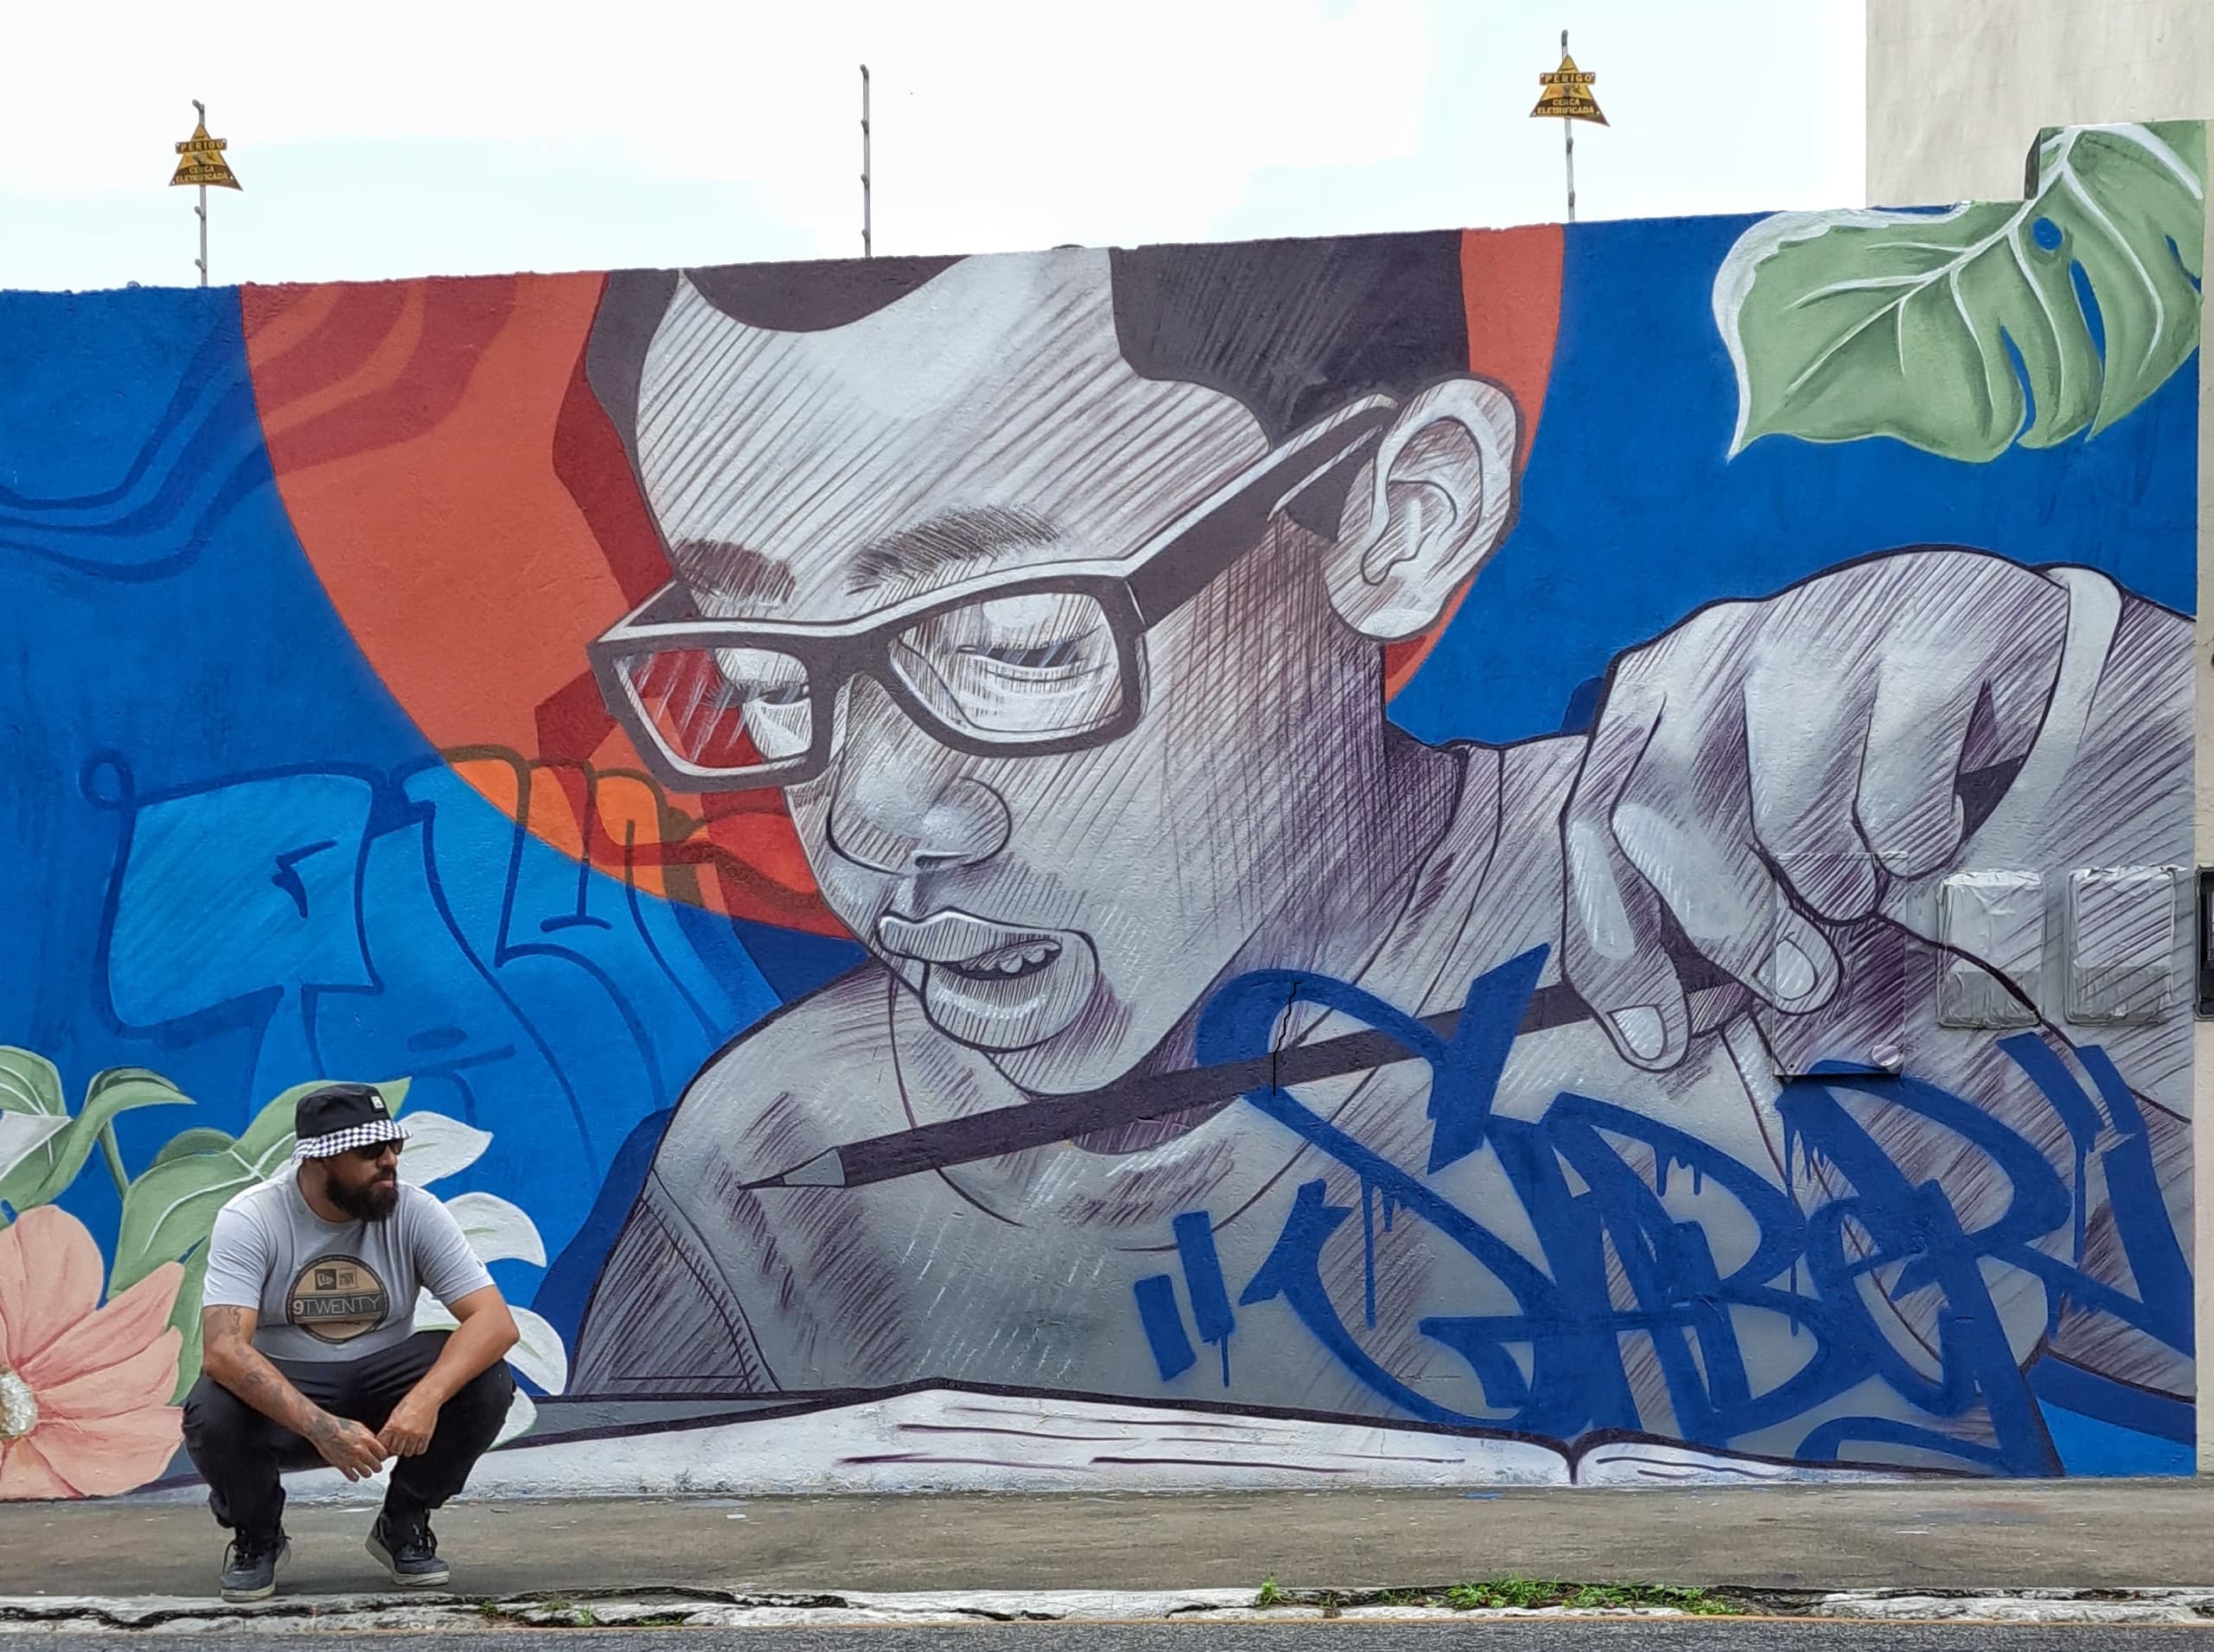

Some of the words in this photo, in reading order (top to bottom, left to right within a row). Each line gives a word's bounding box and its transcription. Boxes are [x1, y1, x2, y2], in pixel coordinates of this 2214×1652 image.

[1545, 74, 1592, 83] PERIGO
[1552, 98, 1580, 106] CERCA
[1537, 106, 1595, 114] ELETRIFICADA
[180, 140, 224, 152] PERIGO
[292, 1297, 381, 1315] 9TWENTY
